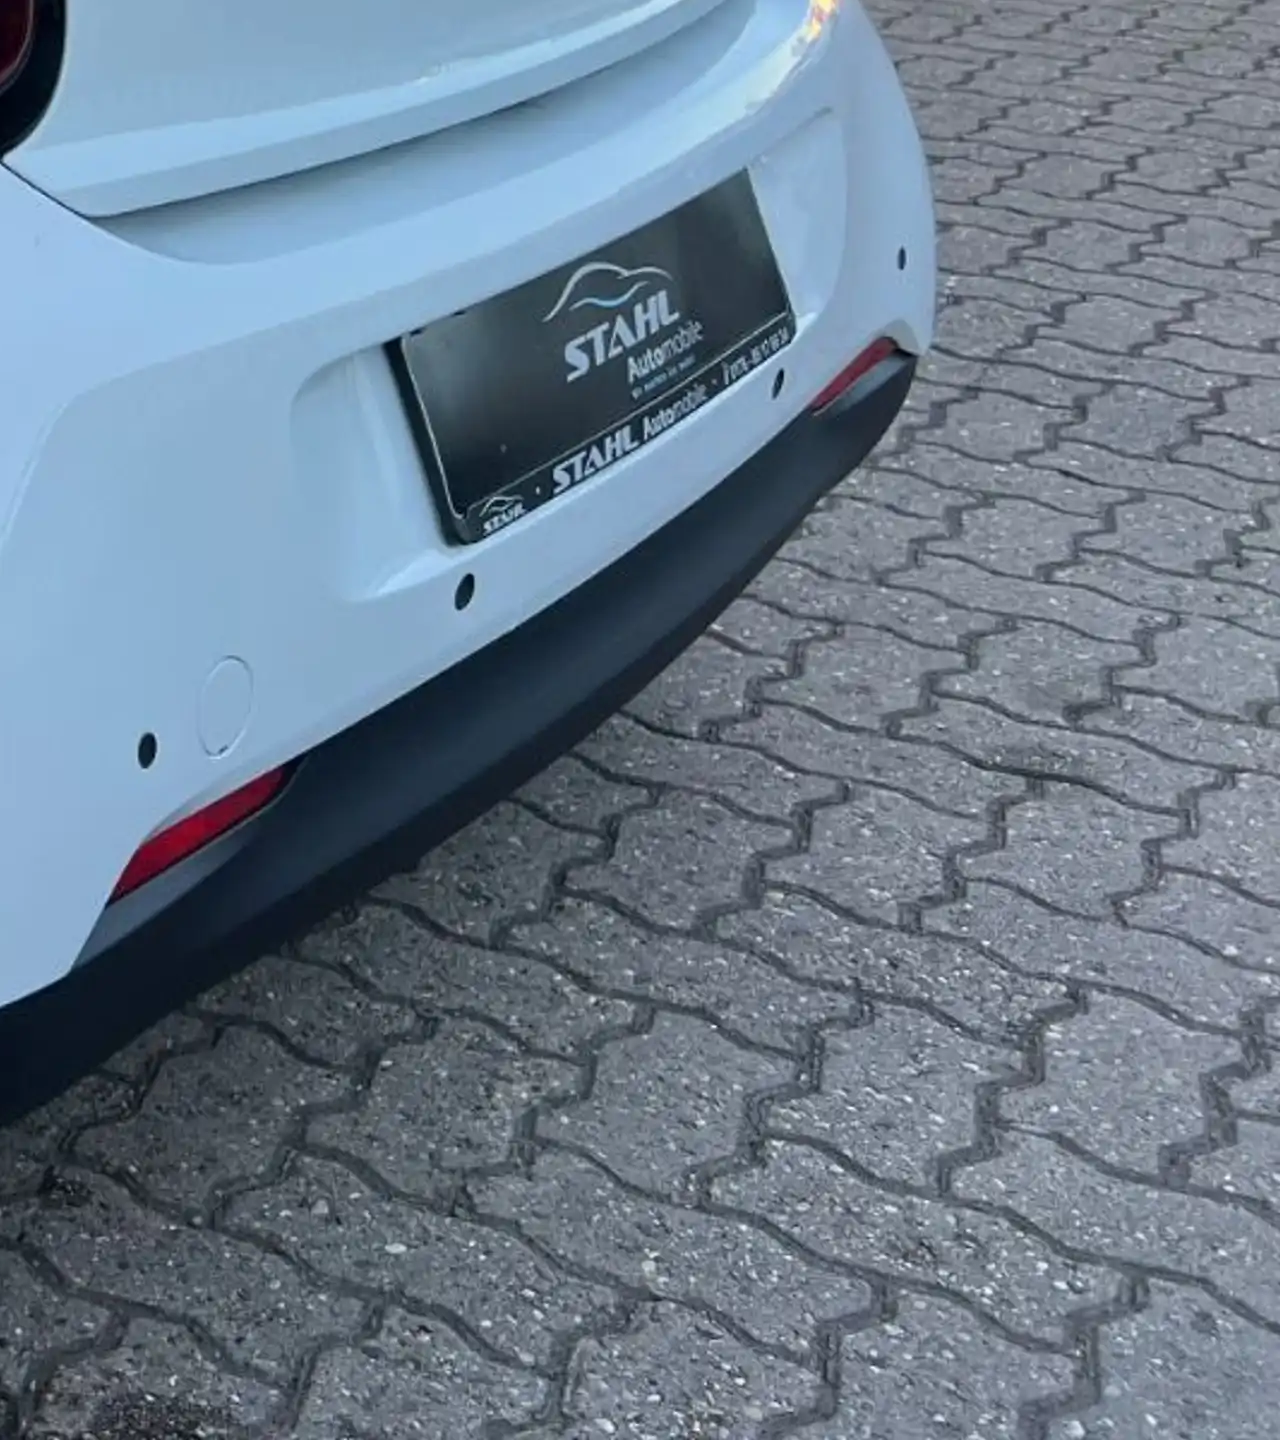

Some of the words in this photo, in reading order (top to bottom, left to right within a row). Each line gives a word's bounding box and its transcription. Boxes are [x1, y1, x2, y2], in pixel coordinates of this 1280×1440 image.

[564, 290, 681, 383] STAHL
[626, 320, 704, 385] Automobile
[552, 425, 640, 495] STAHL
